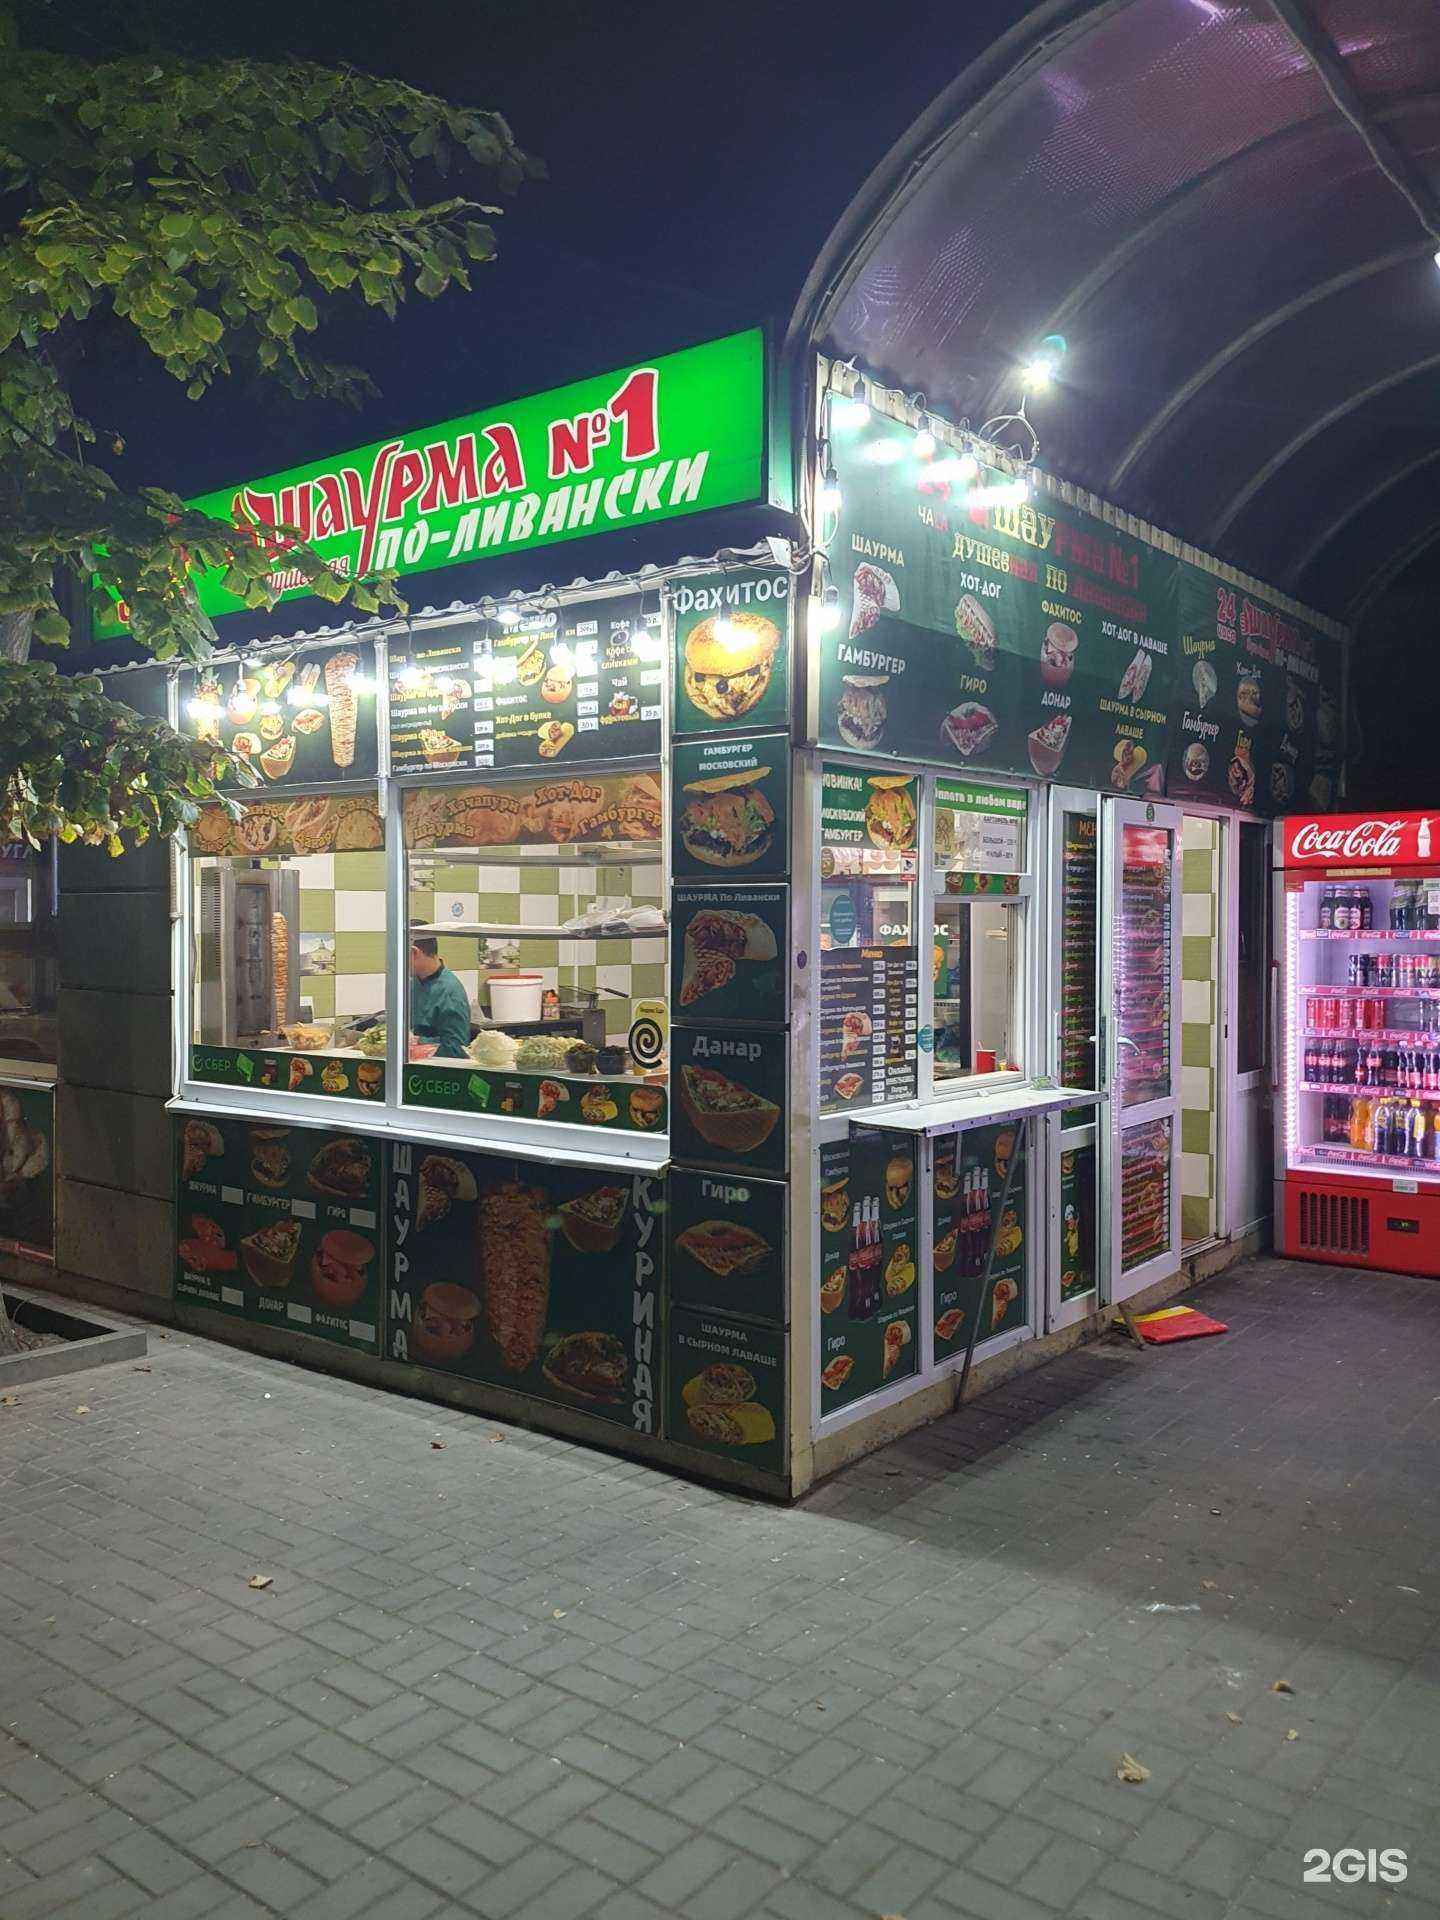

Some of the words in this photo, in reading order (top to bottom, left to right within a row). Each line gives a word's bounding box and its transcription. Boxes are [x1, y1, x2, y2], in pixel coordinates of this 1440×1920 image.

[547, 366, 660, 480] №1
[851, 533, 905, 568] ШАУРМА
[672, 576, 788, 614] Фахитос
[960, 571, 1002, 599] ХОТ-ДОГ
[1041, 600, 1082, 625] ФАХИТОС
[1216, 587, 1236, 627] 24
[1101, 619, 1133, 643] ХОТ-ДОГ
[1140, 636, 1168, 656] ЛАВАШЕ
[837, 644, 906, 675] ГАМБУРГЕР
[960, 673, 987, 694] ГИРО
[1041, 691, 1071, 710] ДОНАР
[698, 756, 758, 772] МОСКОВСКИЙ
[703, 743, 753, 757] ГАМБУРГЕР
[1291, 820, 1409, 859] Coca-Cola
[692, 1035, 763, 1062] Данар
[425, 1080, 460, 1096] СБЕР
[701, 1179, 751, 1205] Гиро
[390, 1142, 413, 1361] ШАУРМА
[631, 1175, 656, 1435] КУРИНАЯ
[701, 1322, 749, 1343] ШАУРМА
[678, 1334, 686, 1345] В
[731, 1348, 778, 1368] ЛАВАШЕ
